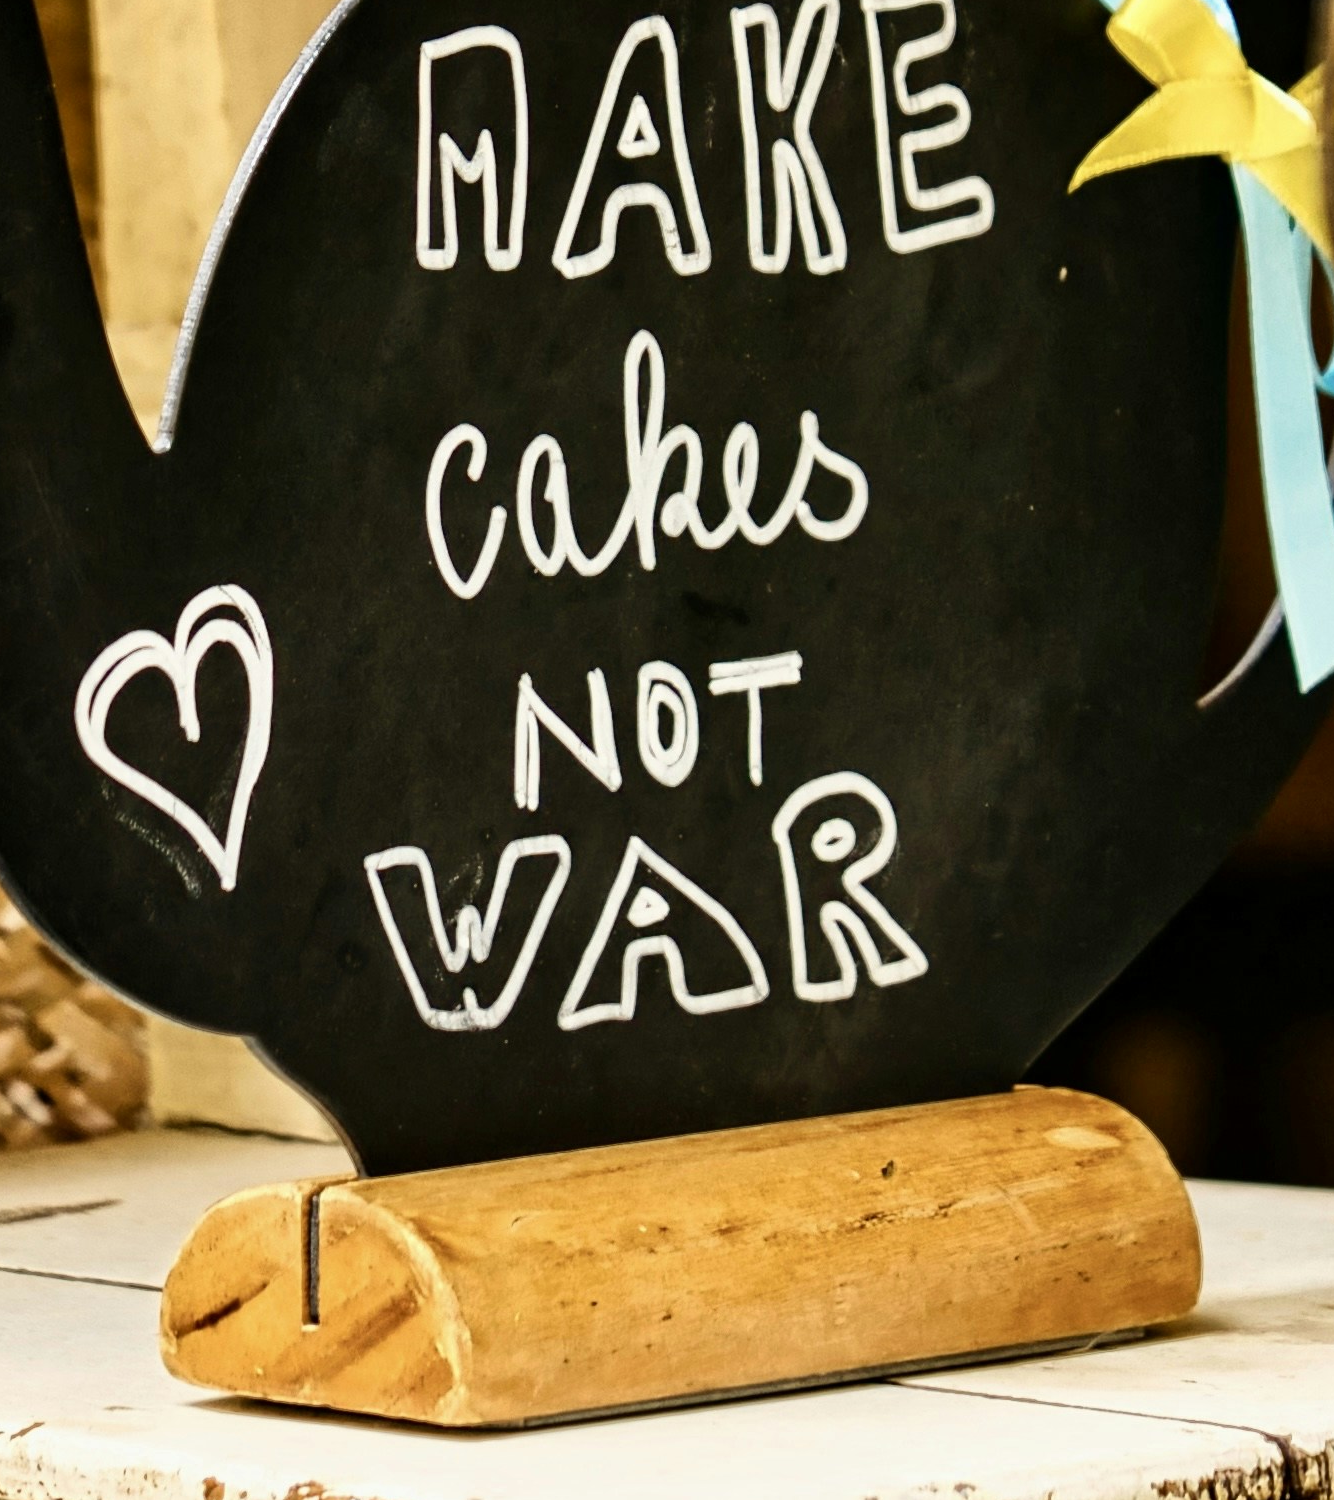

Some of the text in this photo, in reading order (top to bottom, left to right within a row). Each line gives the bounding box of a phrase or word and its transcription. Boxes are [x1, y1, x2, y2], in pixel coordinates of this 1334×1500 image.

[425, 330, 869, 600] cakes
[514, 650, 803, 812] NOT
[363, 770, 929, 1032] WAR
